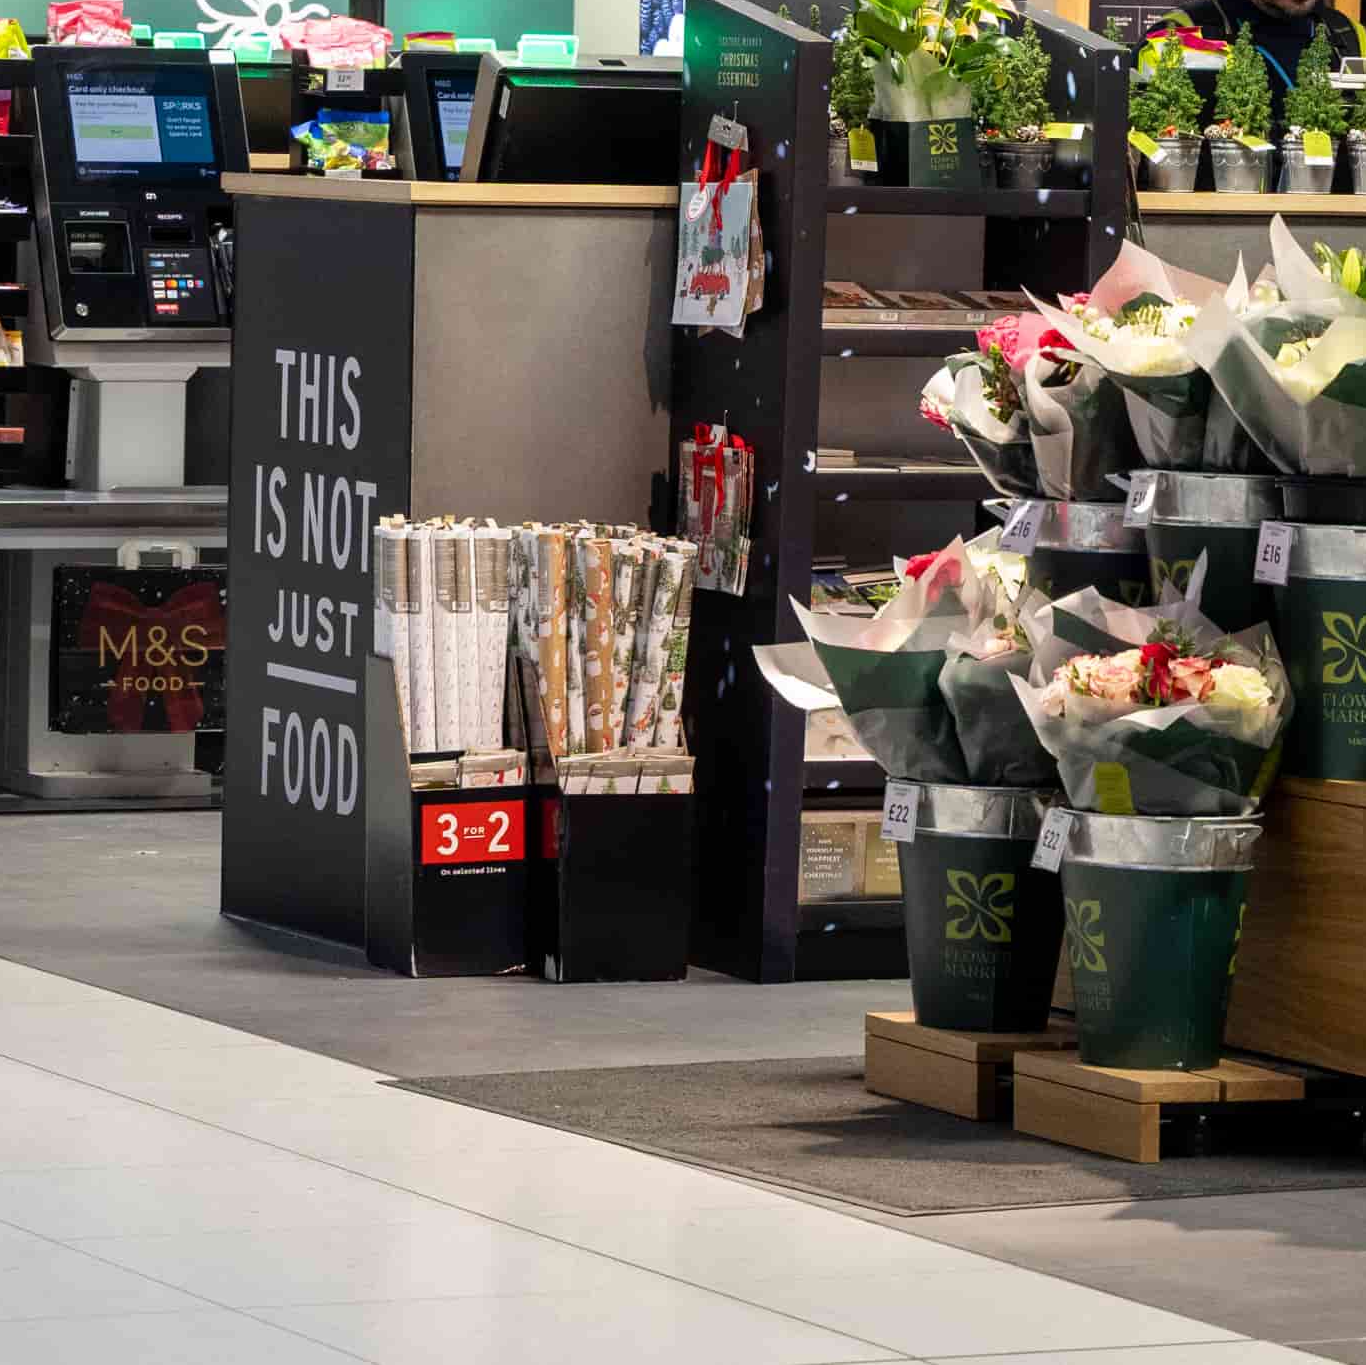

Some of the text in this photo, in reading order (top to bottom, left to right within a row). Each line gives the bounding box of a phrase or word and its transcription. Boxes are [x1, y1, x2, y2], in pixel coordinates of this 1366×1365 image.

[68, 85, 89, 93] Card
[274, 349, 363, 451] THIS
[253, 464, 288, 559] IS
[302, 474, 378, 574] NOT
[1009, 519, 1030, 538] £16
[1261, 544, 1282, 564] £16
[267, 587, 359, 658] JUST
[98, 624, 210, 668] M&S
[121, 675, 185, 693] FOOD
[259, 707, 359, 816] FOOD
[888, 803, 910, 823] £22
[436, 810, 510, 856] 3 FOR 2
[1041, 829, 1061, 851] £22
[440, 866, 506, 876] On selected lines
